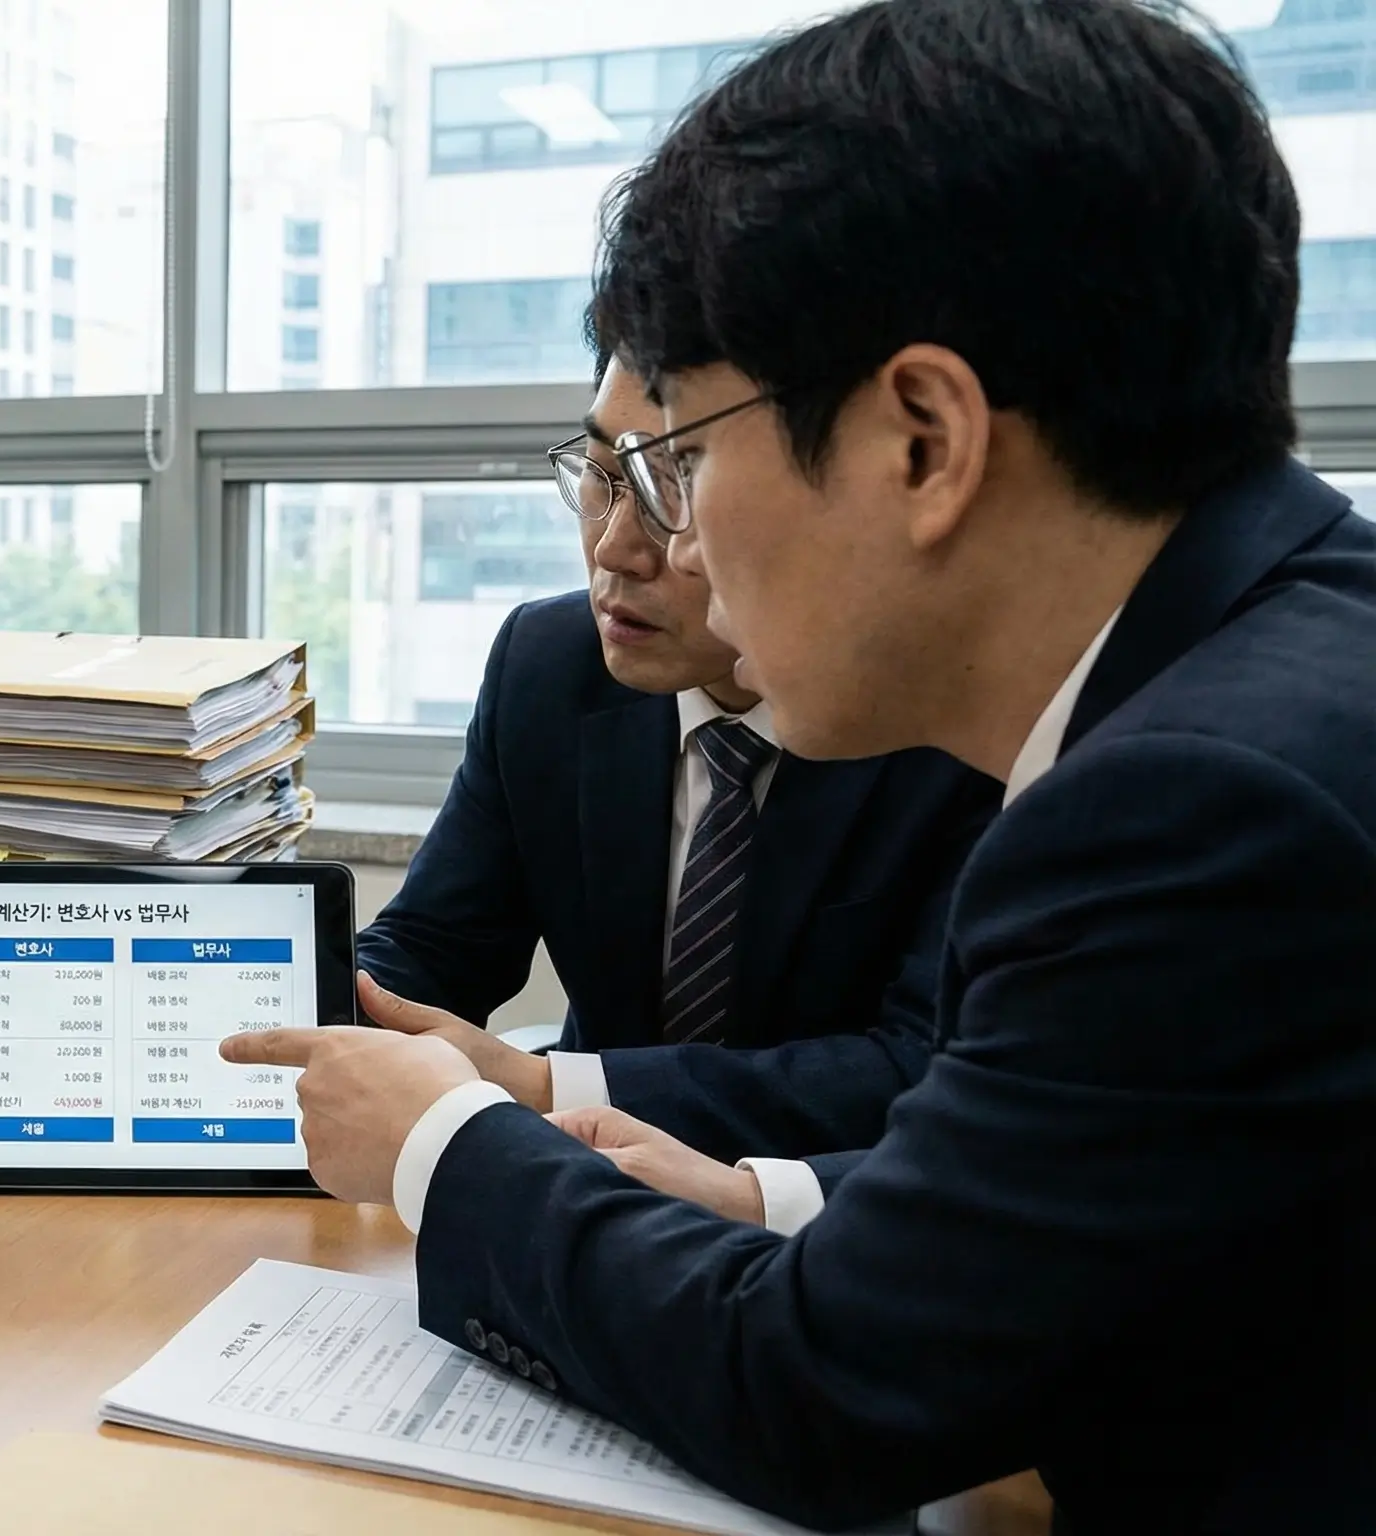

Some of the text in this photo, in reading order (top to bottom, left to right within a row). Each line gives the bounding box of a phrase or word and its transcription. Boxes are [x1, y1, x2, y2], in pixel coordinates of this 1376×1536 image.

[57, 902, 110, 923] 변호사
[113, 908, 133, 922] vs
[138, 903, 190, 924] 법무사
[192, 942, 232, 959] 법무사
